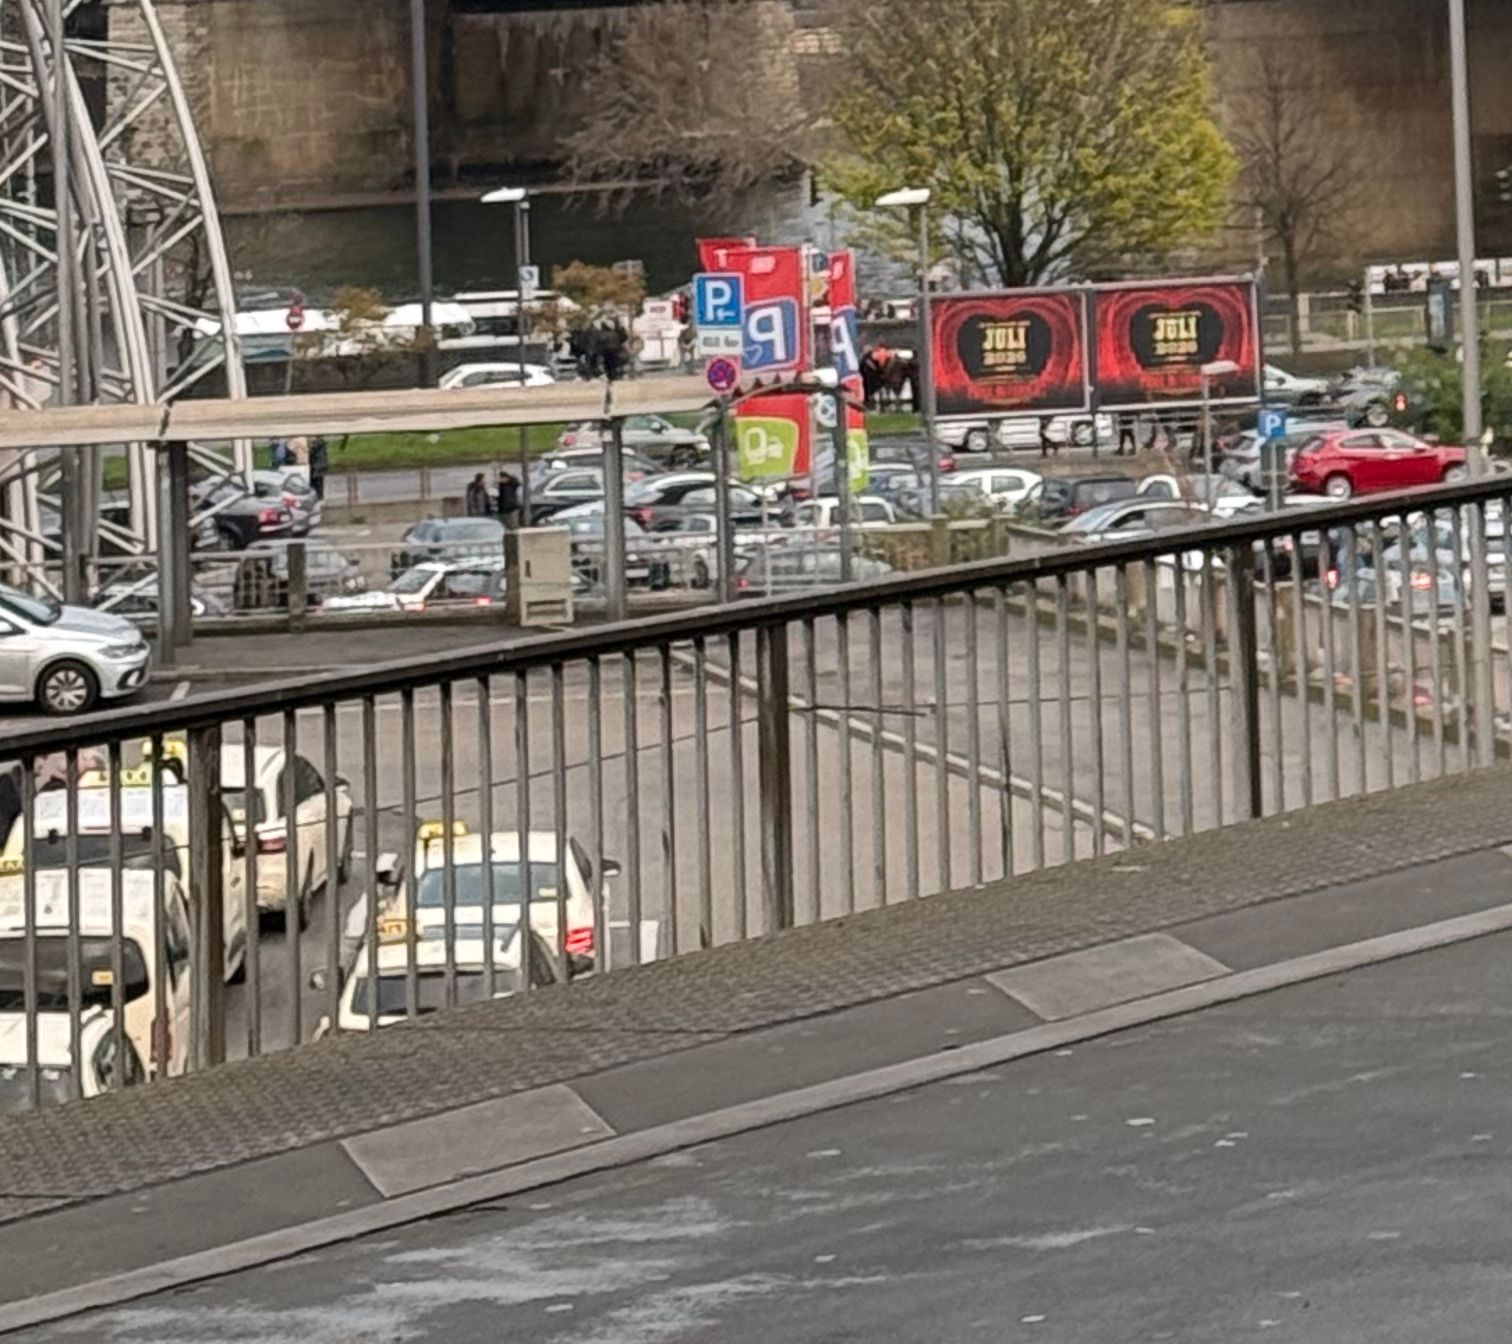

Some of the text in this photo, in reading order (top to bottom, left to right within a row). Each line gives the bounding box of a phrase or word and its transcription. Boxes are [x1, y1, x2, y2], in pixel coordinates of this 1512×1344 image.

[704, 280, 731, 321] P
[982, 327, 1026, 350] JULI
[1152, 317, 1197, 340] JULI
[1264, 414, 1282, 436] P
